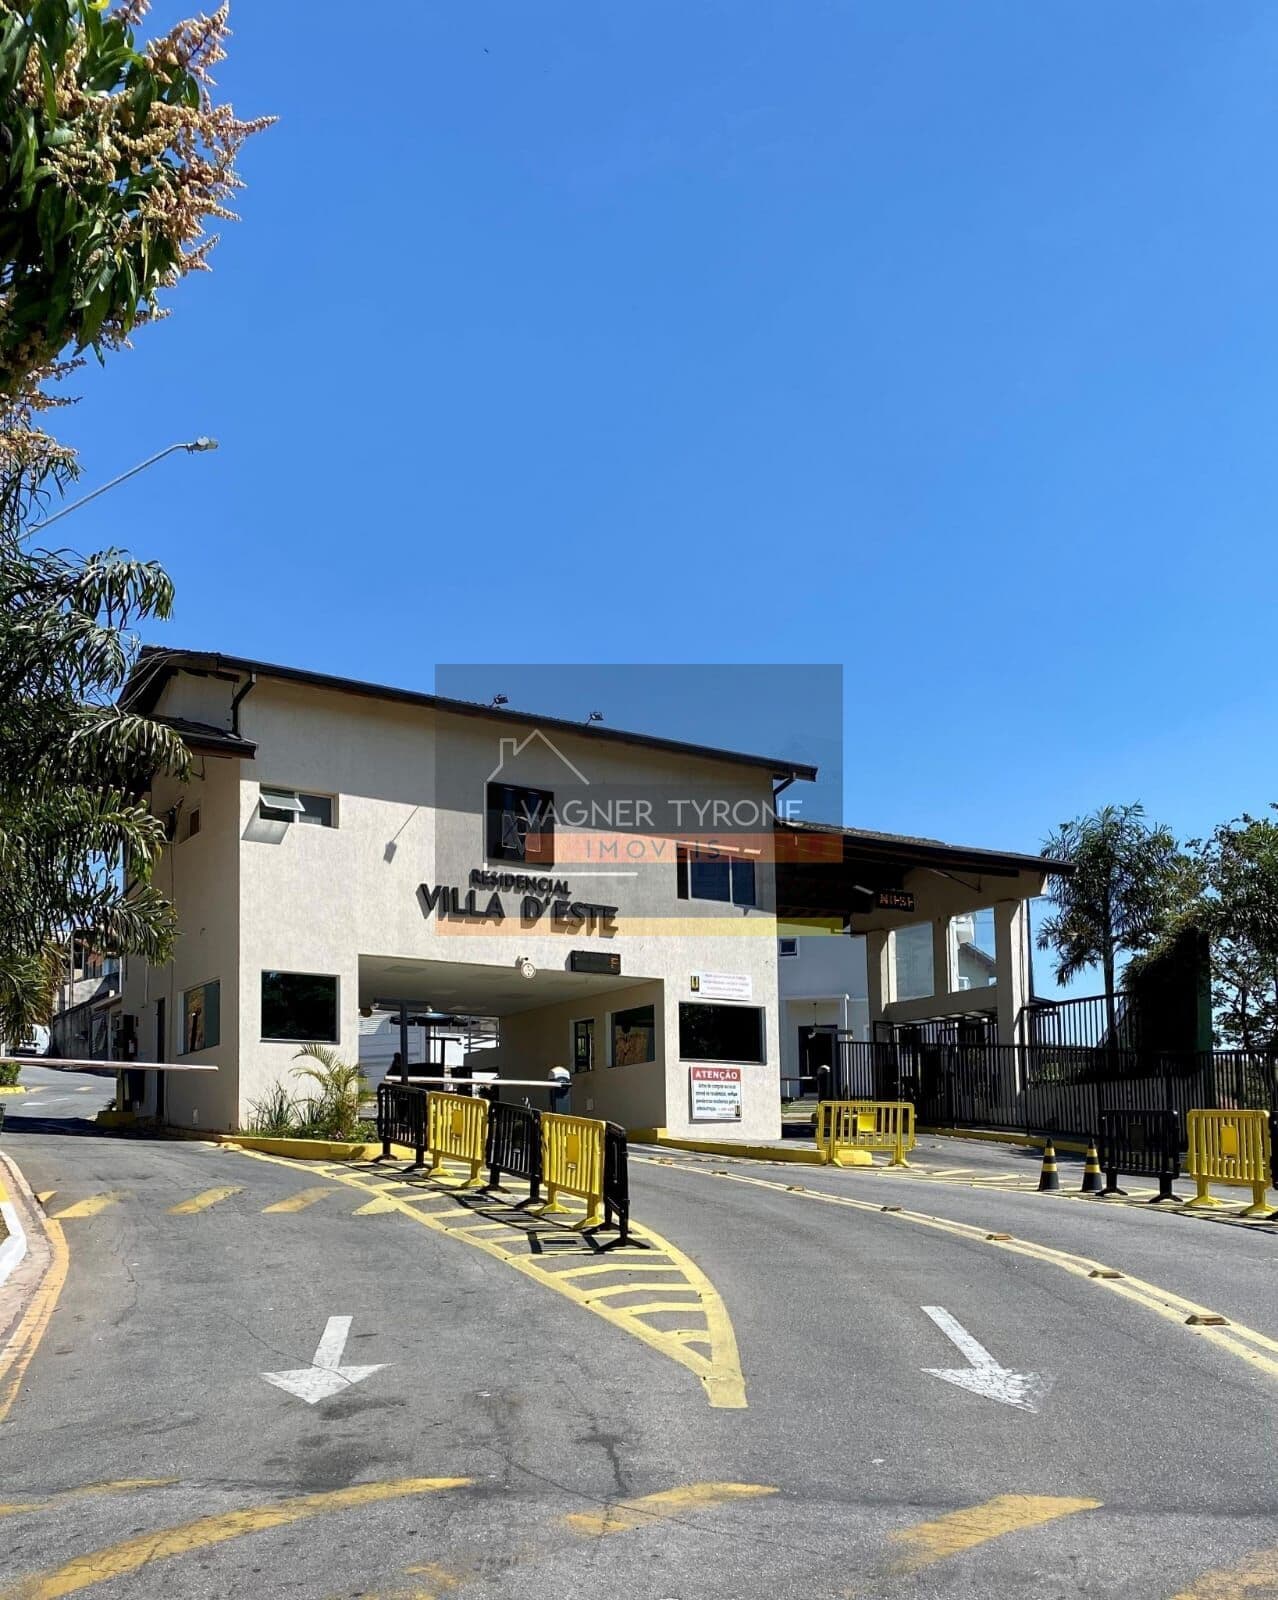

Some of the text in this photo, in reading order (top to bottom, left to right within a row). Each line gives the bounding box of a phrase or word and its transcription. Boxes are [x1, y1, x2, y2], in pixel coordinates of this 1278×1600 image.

[469, 868, 572, 899] RESIDENCIAL
[415, 883, 619, 938] VILLA D'ESTE
[695, 1069, 738, 1081] ATENÇÃO
